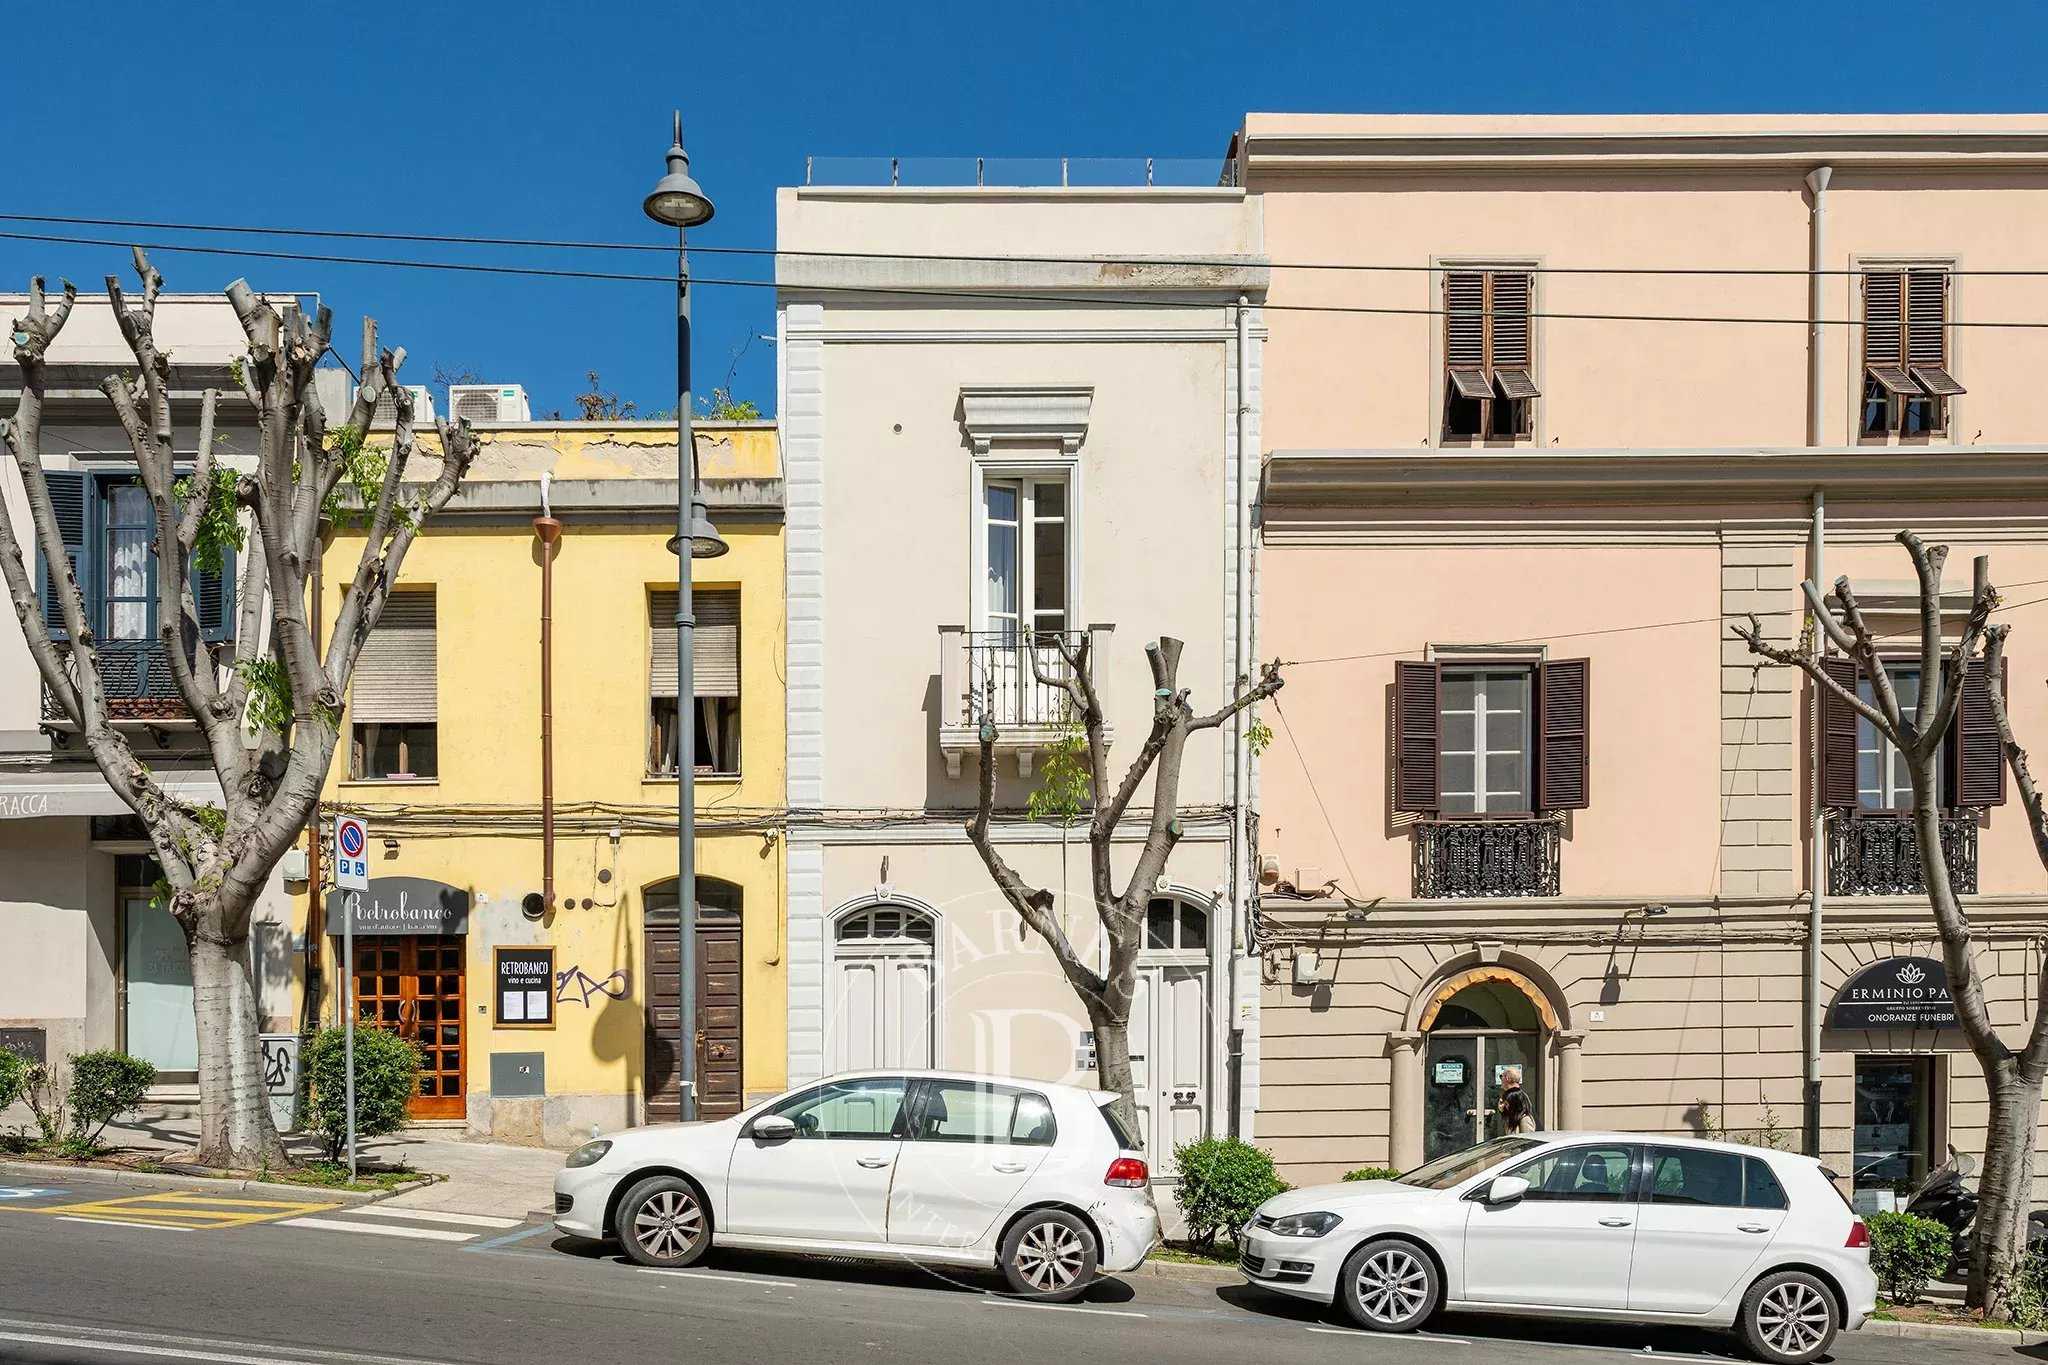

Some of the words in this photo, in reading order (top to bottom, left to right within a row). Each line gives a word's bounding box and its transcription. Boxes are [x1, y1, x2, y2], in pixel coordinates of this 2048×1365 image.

[0, 794, 48, 816] RACCA
[341, 890, 452, 921] Retrobanco
[501, 961, 549, 975] RETROBANCO
[508, 976, 519, 984] vino
[525, 976, 541, 984] cucina
[1852, 988, 1923, 999] ERMINIO
[1928, 987, 1949, 999] PA
[1868, 1013, 1917, 1022] ONORANZE
[1920, 1013, 1955, 1021] FUNEBRI
